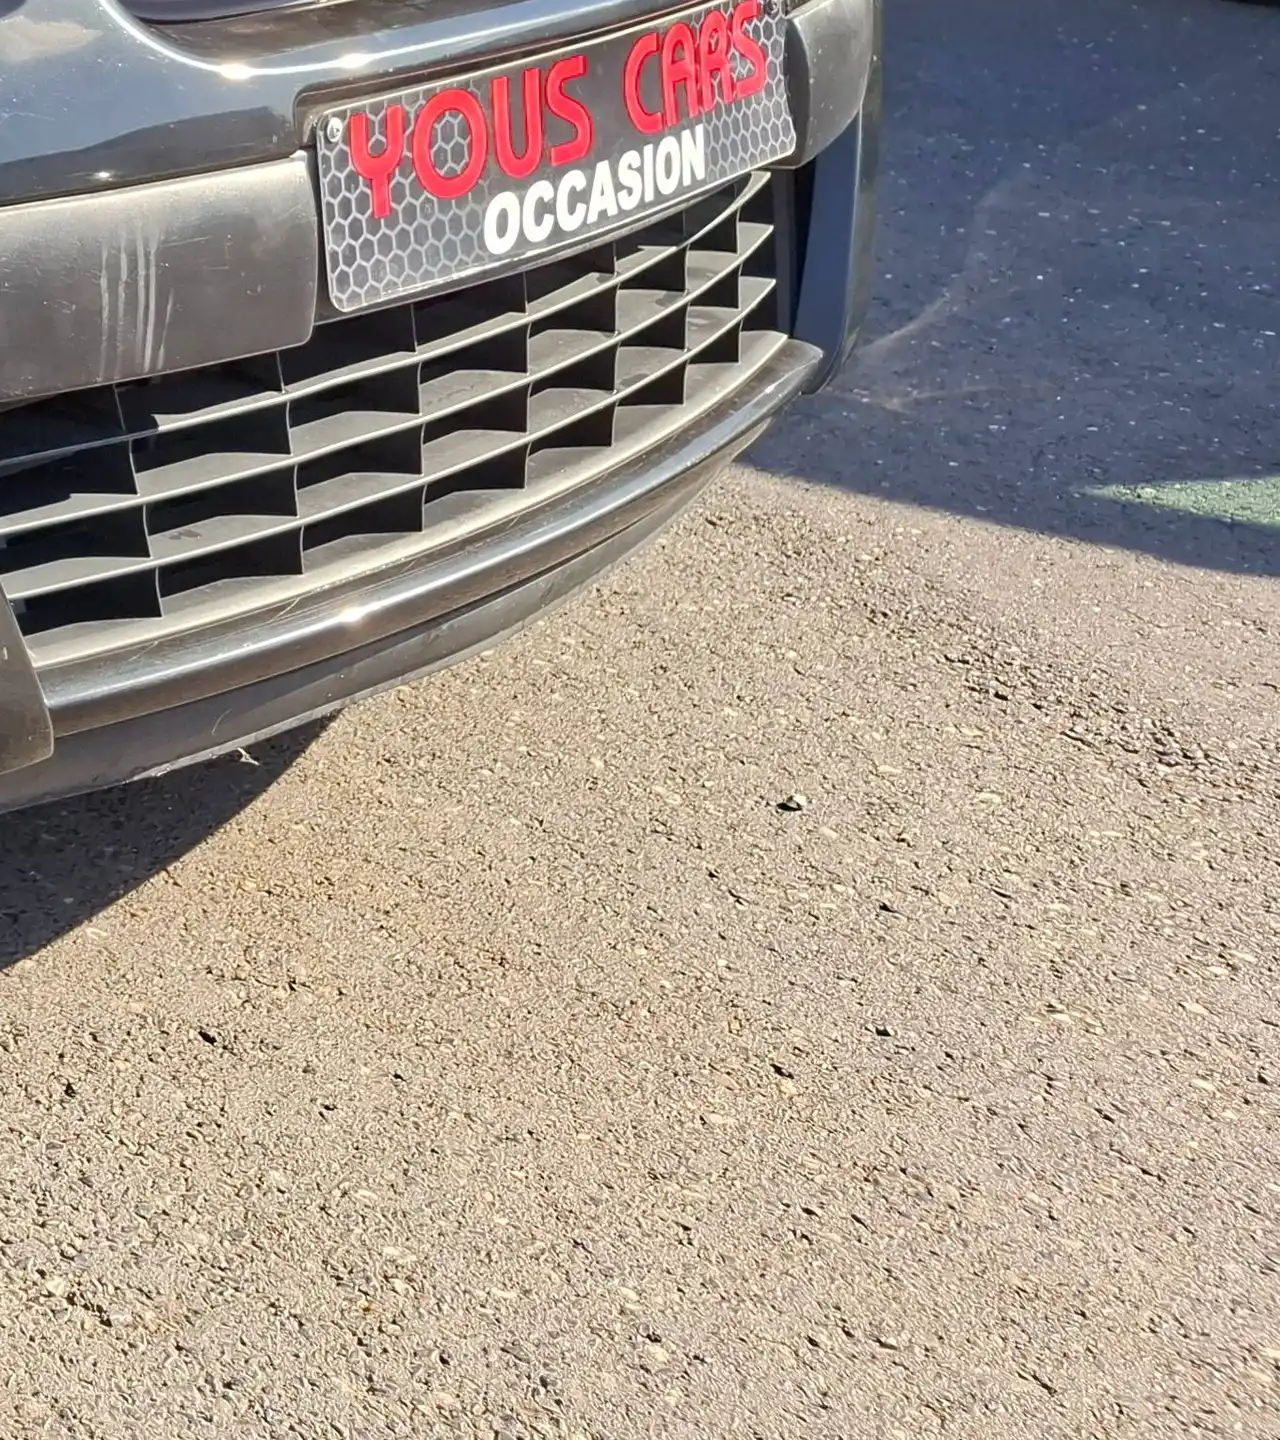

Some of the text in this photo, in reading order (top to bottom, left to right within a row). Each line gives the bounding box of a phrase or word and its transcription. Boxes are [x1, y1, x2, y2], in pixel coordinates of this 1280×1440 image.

[349, 0, 768, 220] YOUS CARS
[483, 122, 706, 256] OCCASION
